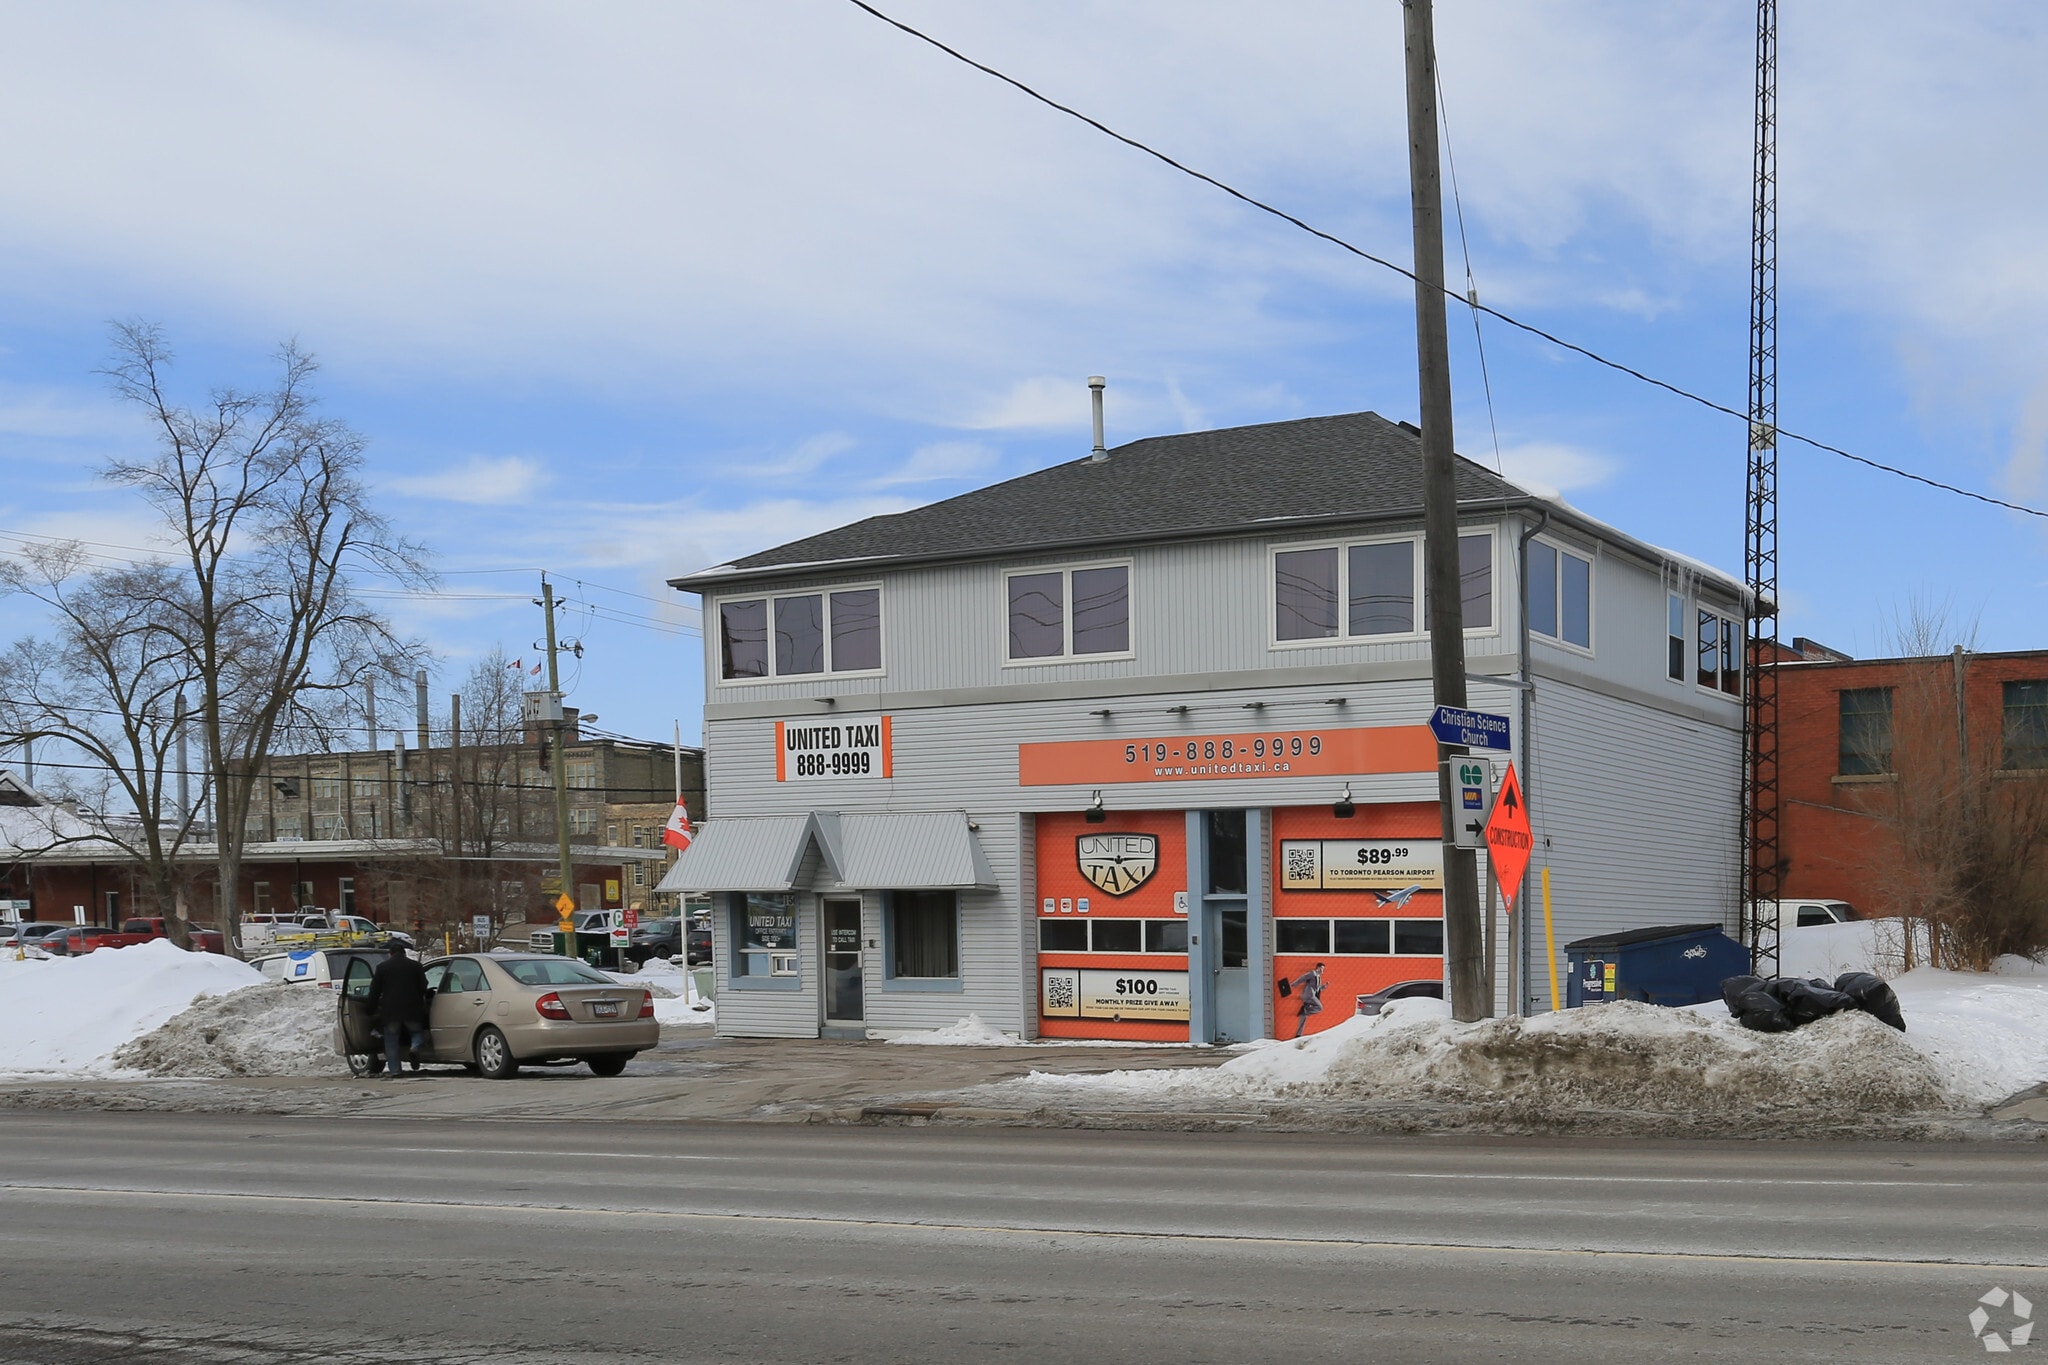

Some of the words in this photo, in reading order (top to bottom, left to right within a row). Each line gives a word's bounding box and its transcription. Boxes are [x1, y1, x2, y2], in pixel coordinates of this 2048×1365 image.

[1441, 709, 1475, 728] Christian
[1477, 715, 1507, 733] Science
[787, 727, 841, 751] UNITED
[846, 725, 879, 748] TAXI
[1461, 728, 1488, 746] Church
[1125, 736, 1322, 763] 519-888-9999
[797, 752, 870, 776] 888-9999
[1154, 761, 1290, 776] www.unitedtaxi.ca
[1080, 836, 1154, 854] UNITED
[1489, 826, 1530, 851] CONSTRUCTION
[1086, 864, 1147, 892] TAXI
[750, 916, 775, 927] UNITED
[777, 916, 793, 927] TAXI
[1116, 978, 1158, 995] $100
